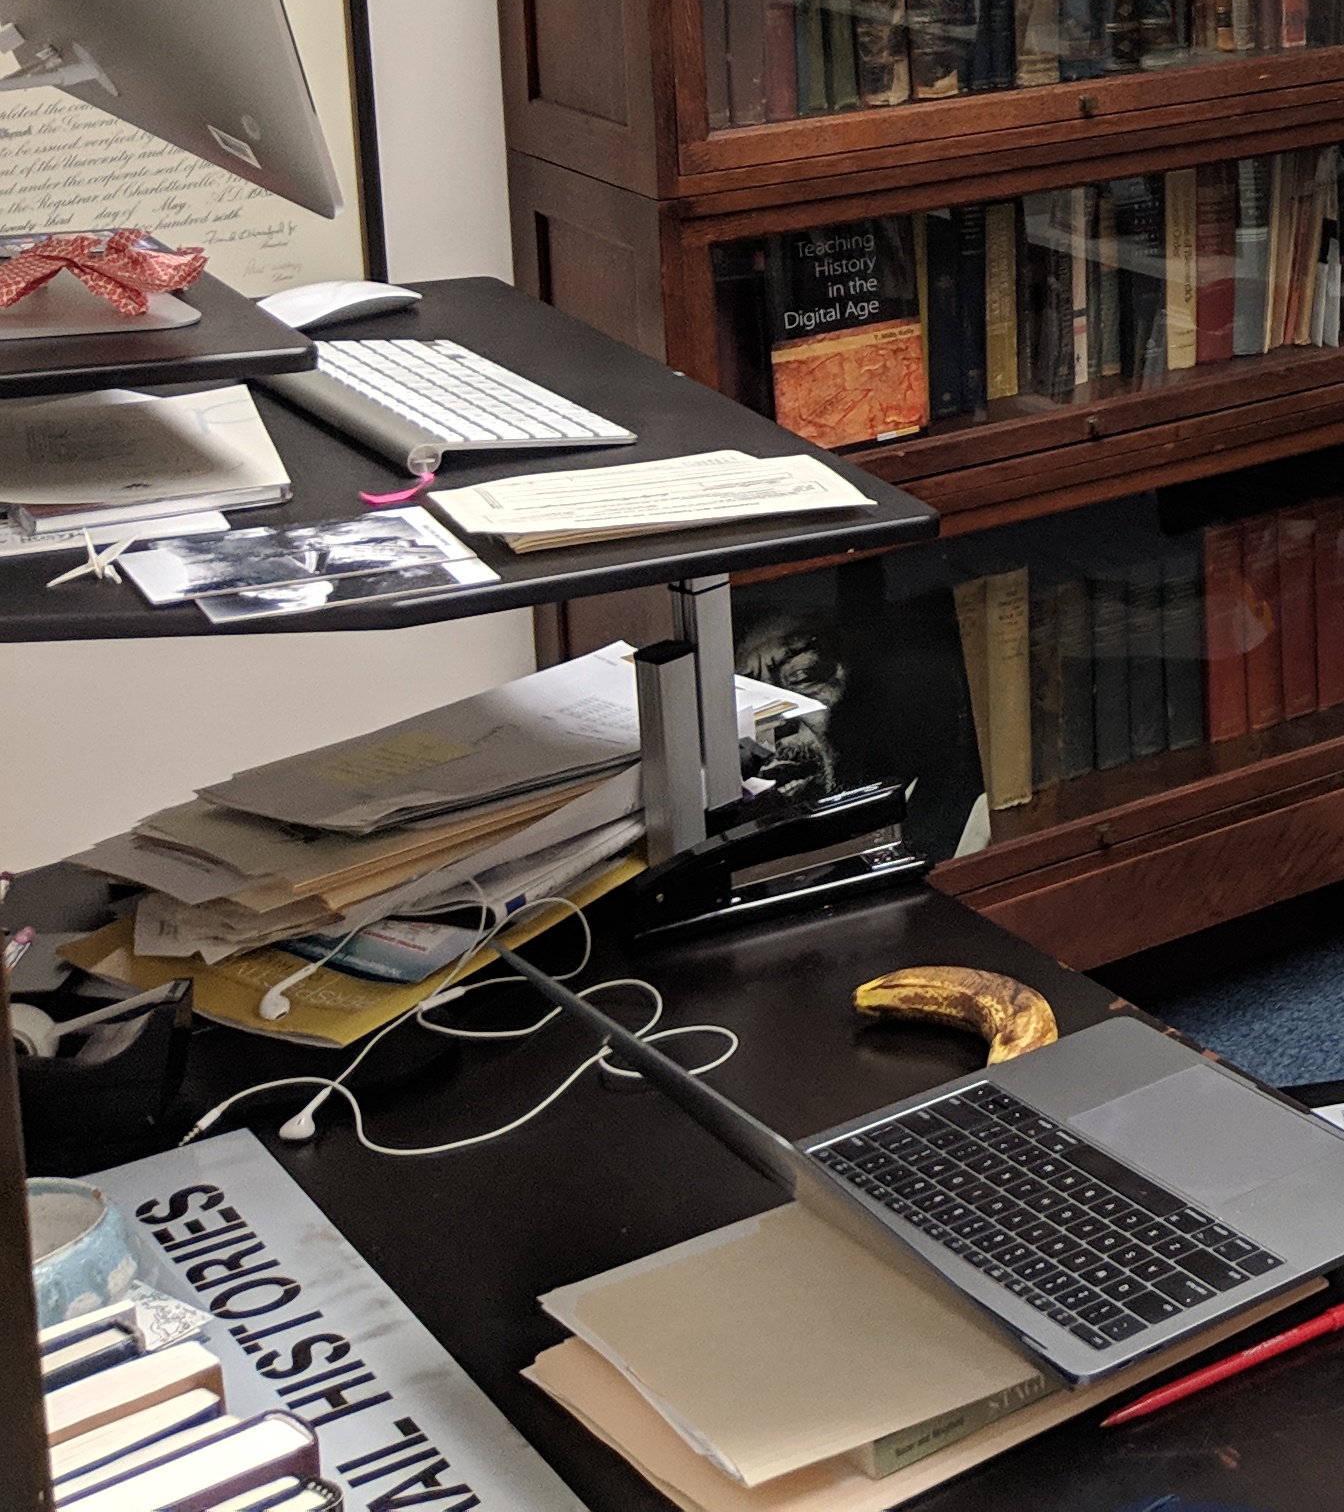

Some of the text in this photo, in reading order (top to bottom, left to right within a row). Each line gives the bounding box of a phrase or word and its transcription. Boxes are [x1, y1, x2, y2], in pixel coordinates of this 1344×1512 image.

[796, 233, 875, 258] Teaching
[815, 255, 877, 278] History
[828, 277, 878, 299] in the
[783, 299, 880, 330] Digital Age
[133, 1182, 395, 1429] HISTORIES
